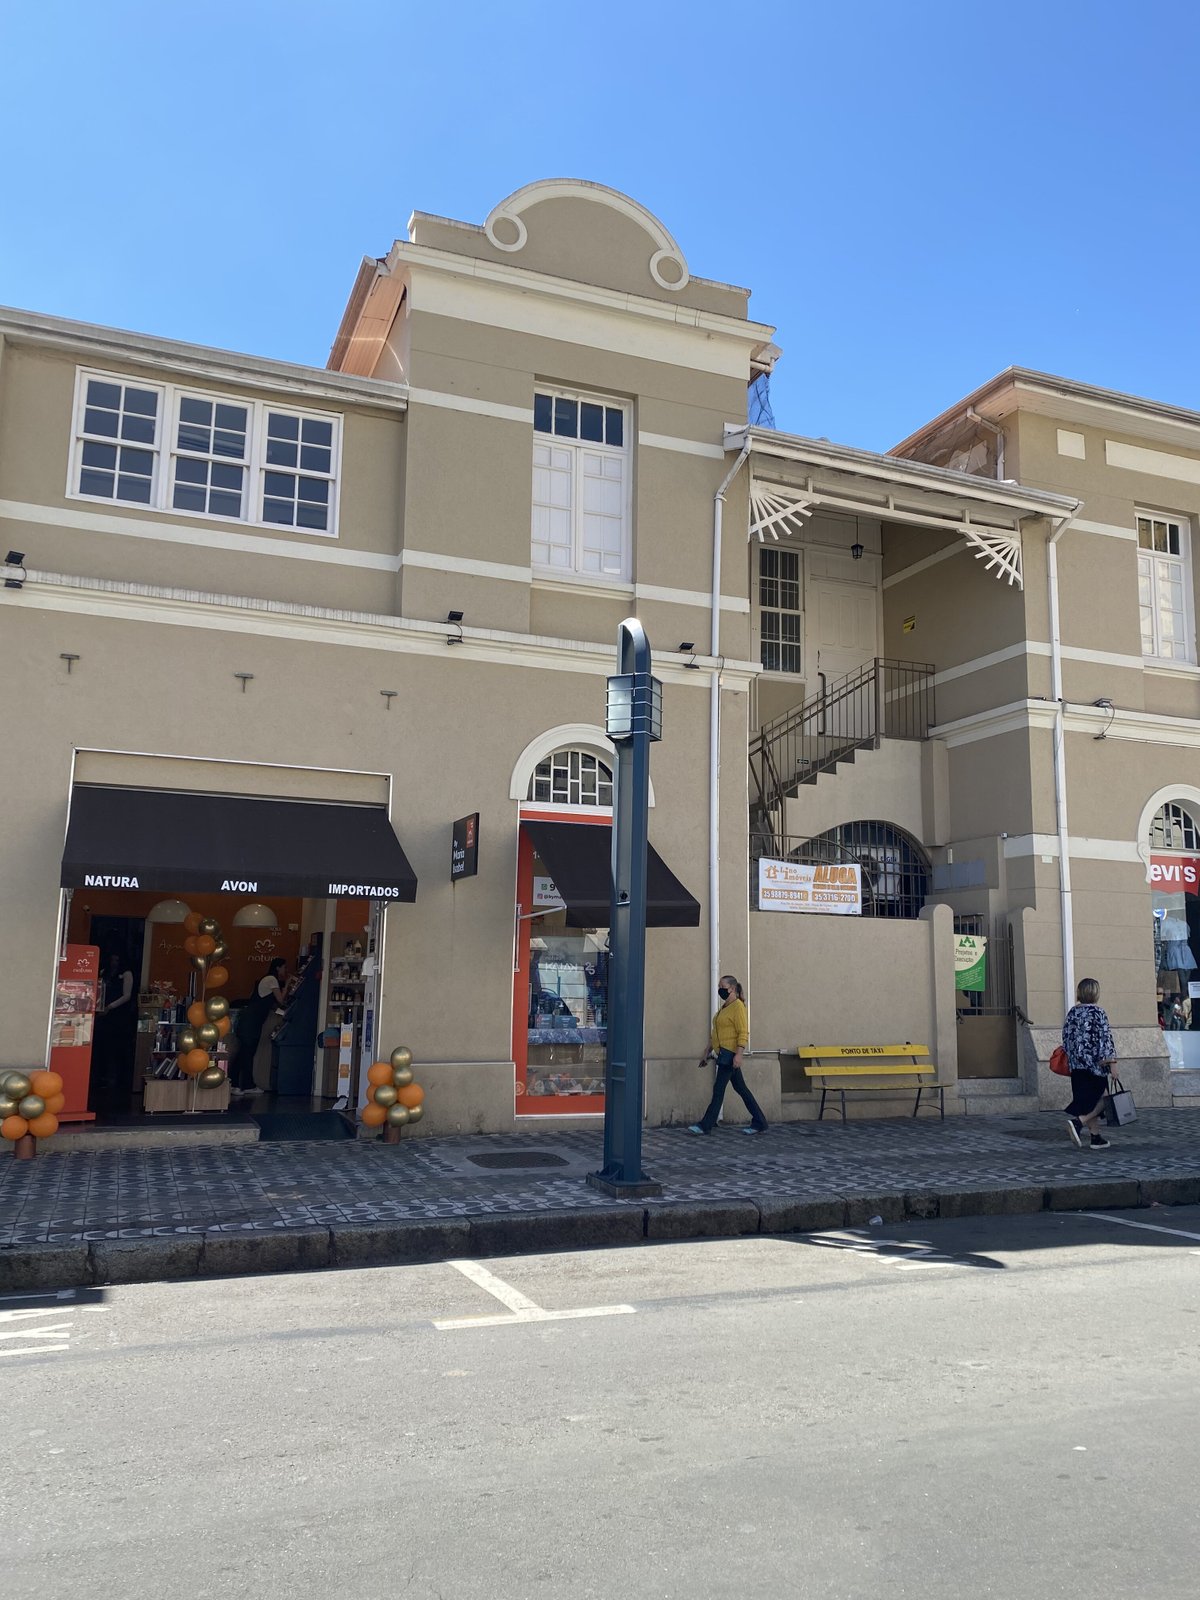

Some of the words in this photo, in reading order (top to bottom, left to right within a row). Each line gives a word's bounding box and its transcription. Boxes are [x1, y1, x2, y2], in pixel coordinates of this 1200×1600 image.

[453, 848, 465, 861] Maria
[452, 861, 465, 874] Isabel
[813, 863, 858, 884] ALUGA
[1150, 864, 1197, 883] evi's
[84, 875, 139, 889] NATURA
[220, 880, 258, 892] AVON
[549, 884, 556, 892] 9
[328, 883, 399, 898] IMPORTADOS
[247, 954, 280, 962] natur
